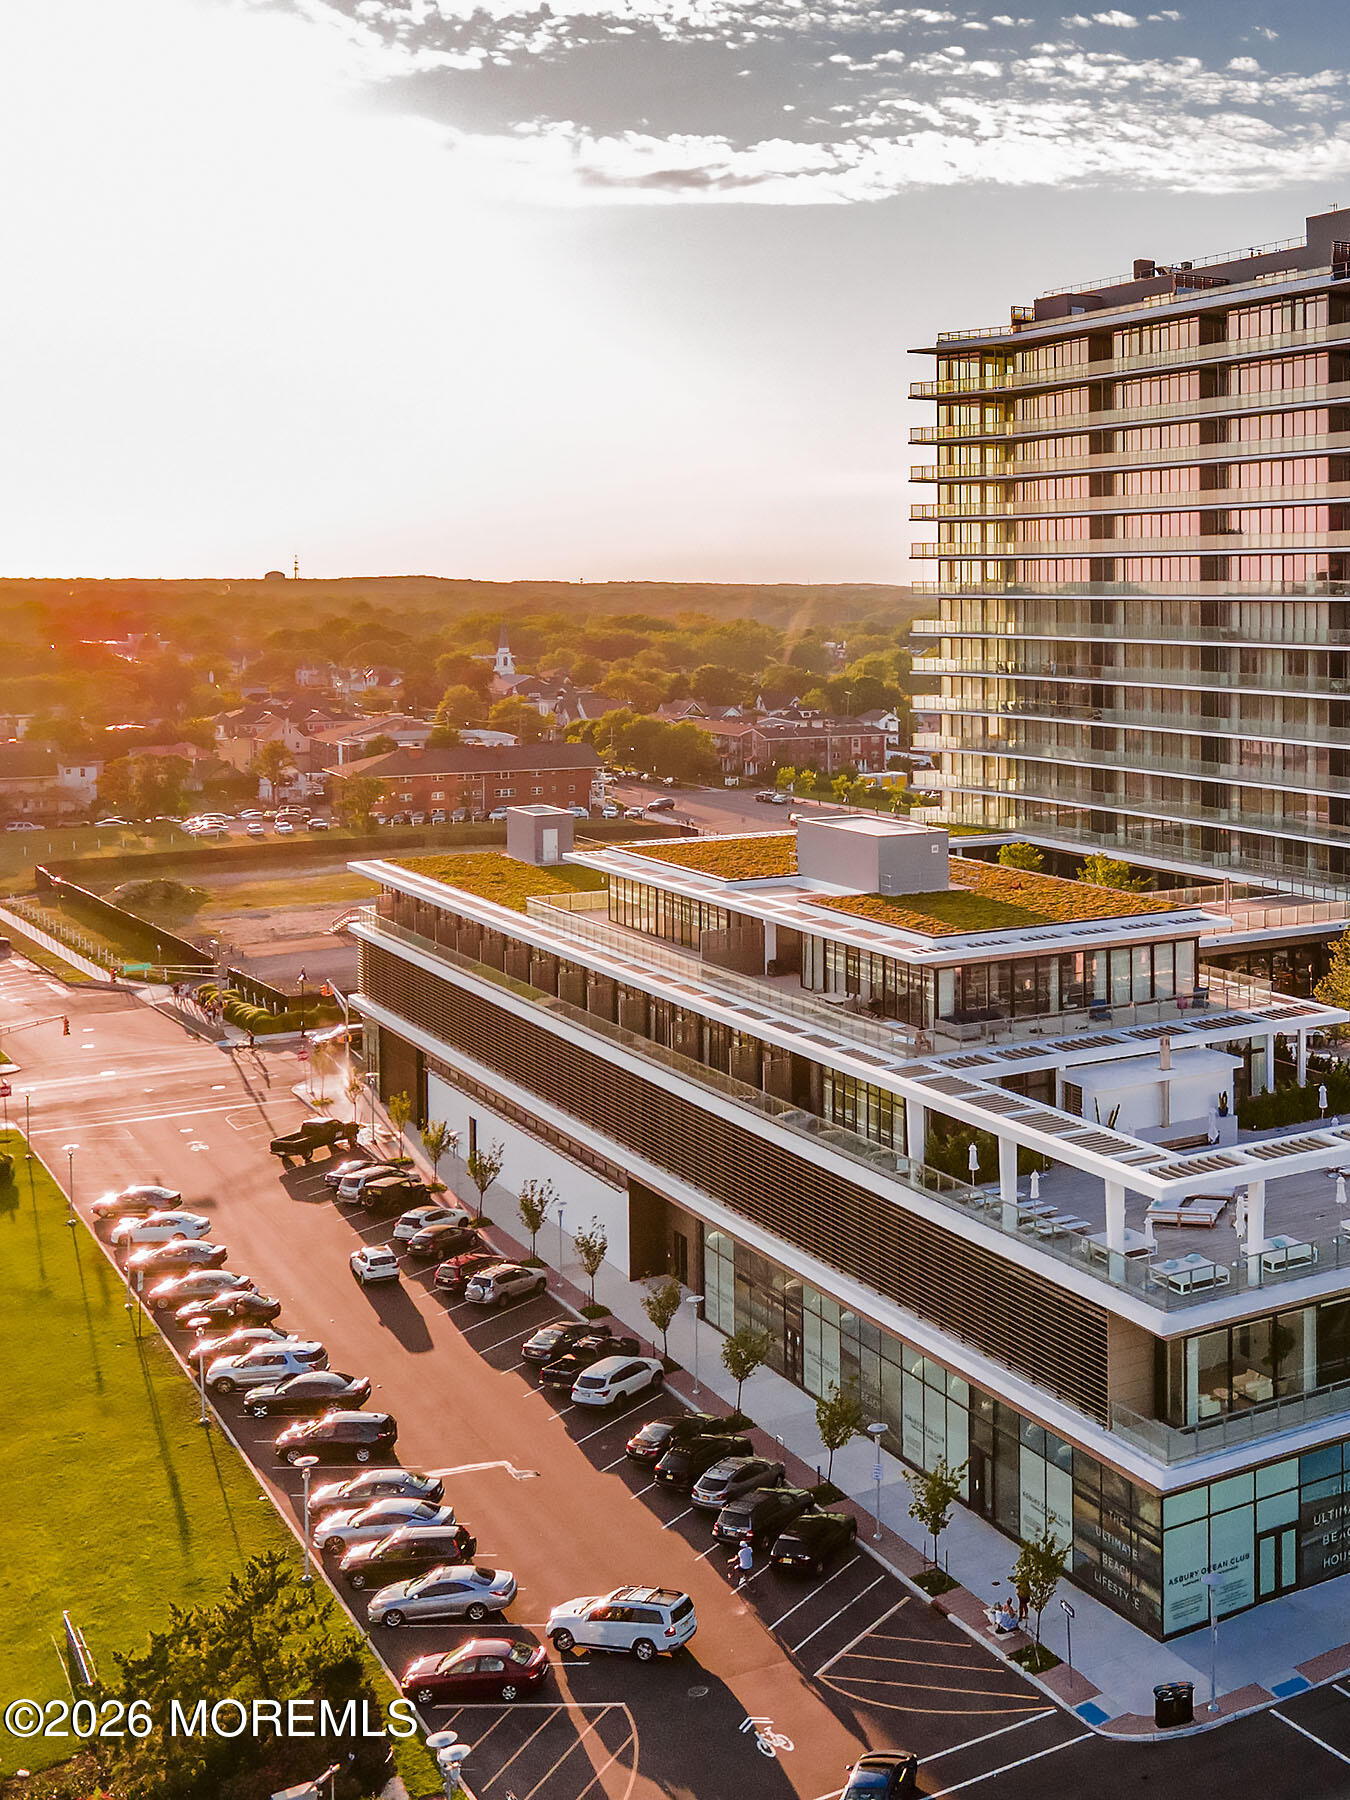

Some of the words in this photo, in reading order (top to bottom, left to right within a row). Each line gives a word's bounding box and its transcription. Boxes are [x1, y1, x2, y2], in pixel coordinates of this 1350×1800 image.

[1095, 1525, 1139, 1561] ULTIMATE
[1168, 1569, 1200, 1586] ASBURY
[1201, 1560, 1228, 1576] OEAN
[1230, 1553, 1250, 1565] CLUB
[1094, 1571, 1141, 1610] LIFESTYE
